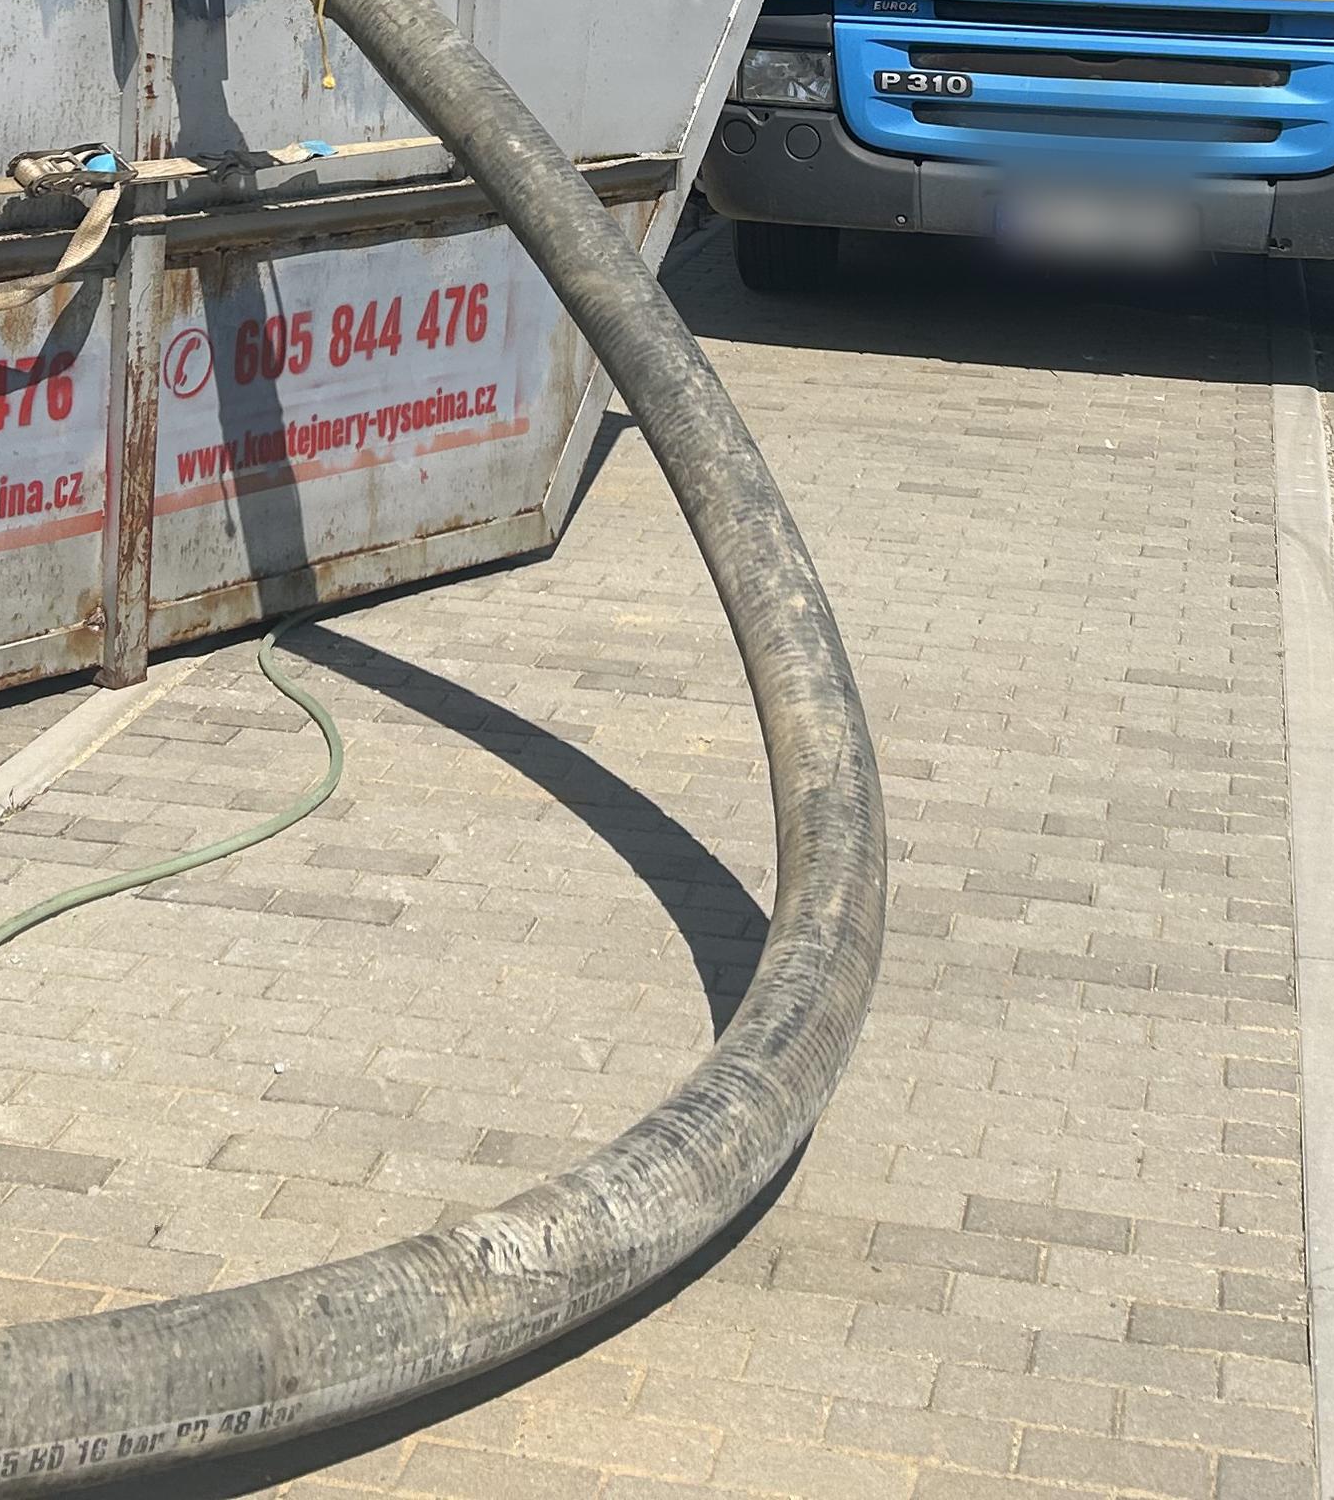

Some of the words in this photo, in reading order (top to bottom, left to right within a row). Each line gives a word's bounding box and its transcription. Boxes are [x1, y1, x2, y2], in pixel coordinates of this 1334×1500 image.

[880, 72, 901, 90] P
[906, 73, 968, 94] 310
[233, 310, 313, 386] 605
[329, 296, 402, 368] 844
[415, 282, 489, 350] 476
[177, 384, 497, 484] www.kontejnery-vysocina.cz
[78, 1437, 108, 1465] 16
